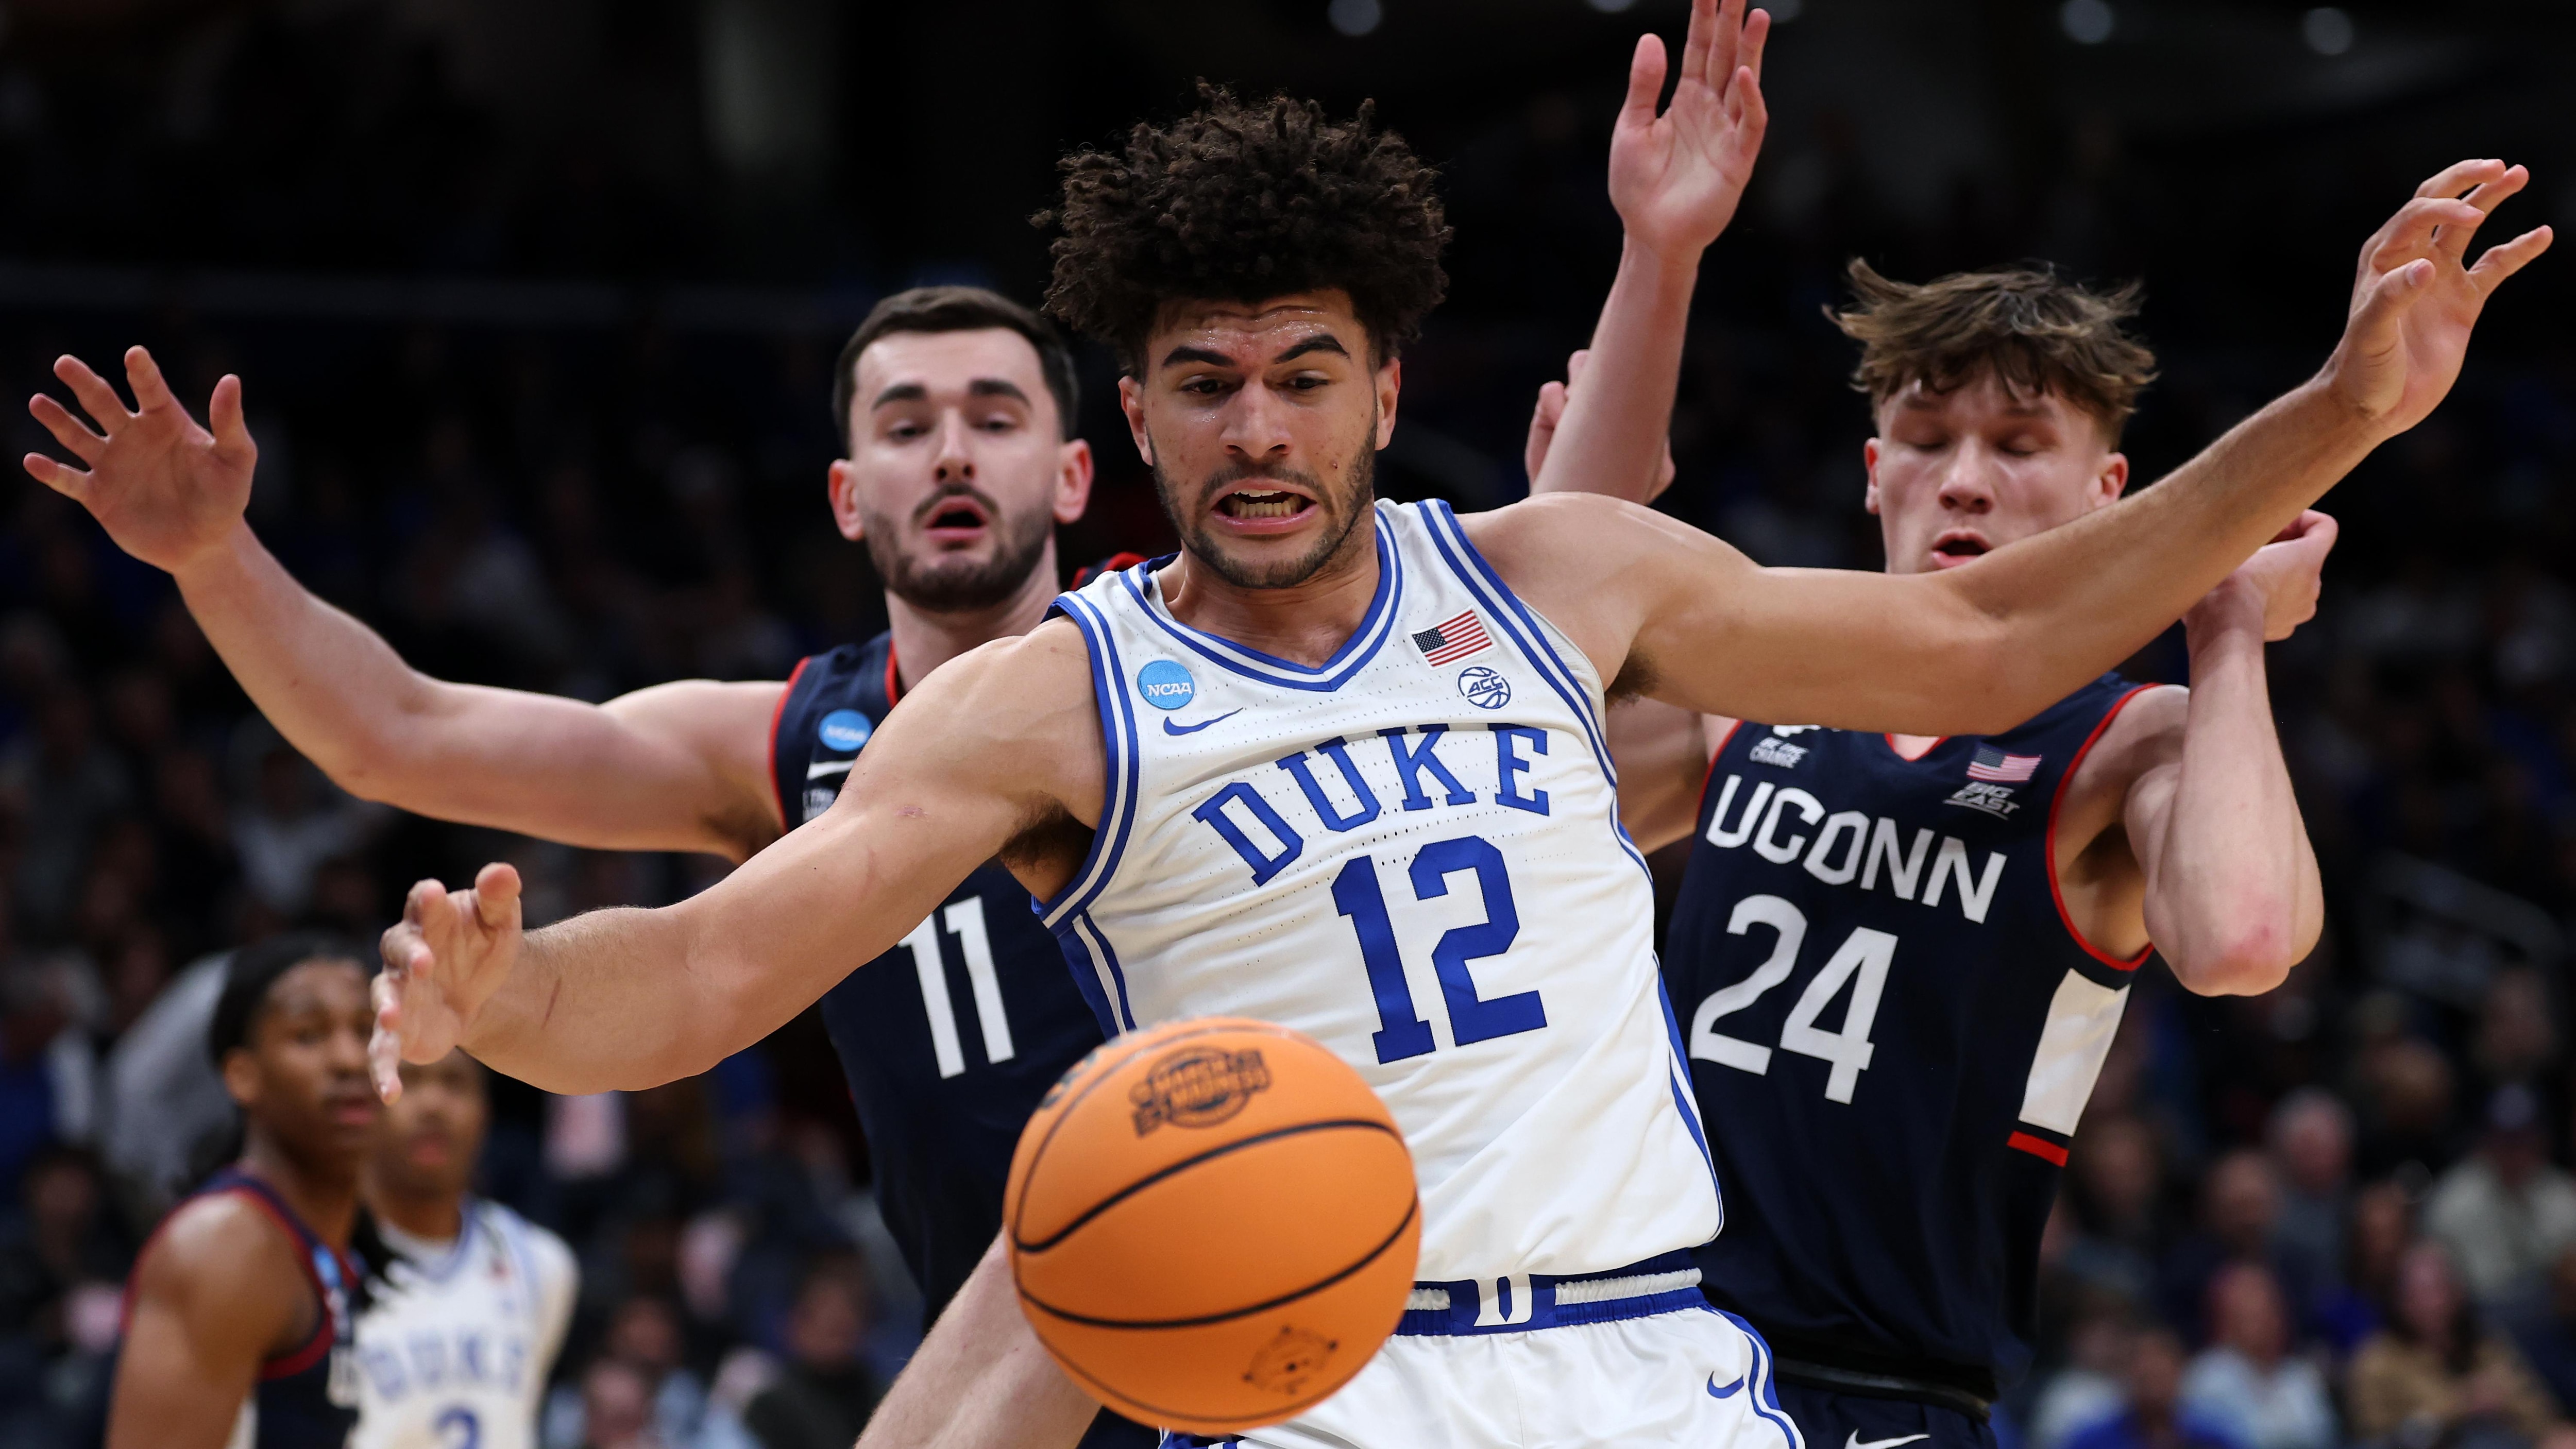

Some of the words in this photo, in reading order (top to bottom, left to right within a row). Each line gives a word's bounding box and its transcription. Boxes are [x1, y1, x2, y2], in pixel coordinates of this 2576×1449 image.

[1147, 683, 1193, 696] NCAA
[1468, 675, 1503, 694] ACC
[1750, 745, 1802, 769] CHANGE
[1965, 781, 2015, 798] BIG
[1192, 722, 1549, 887] DUKE
[1951, 789, 2021, 814] EAST
[1705, 774, 2007, 924] UCONN
[897, 895, 1015, 1079] 11
[1330, 835, 1548, 1064] 12
[1689, 894, 1898, 1105] 24
